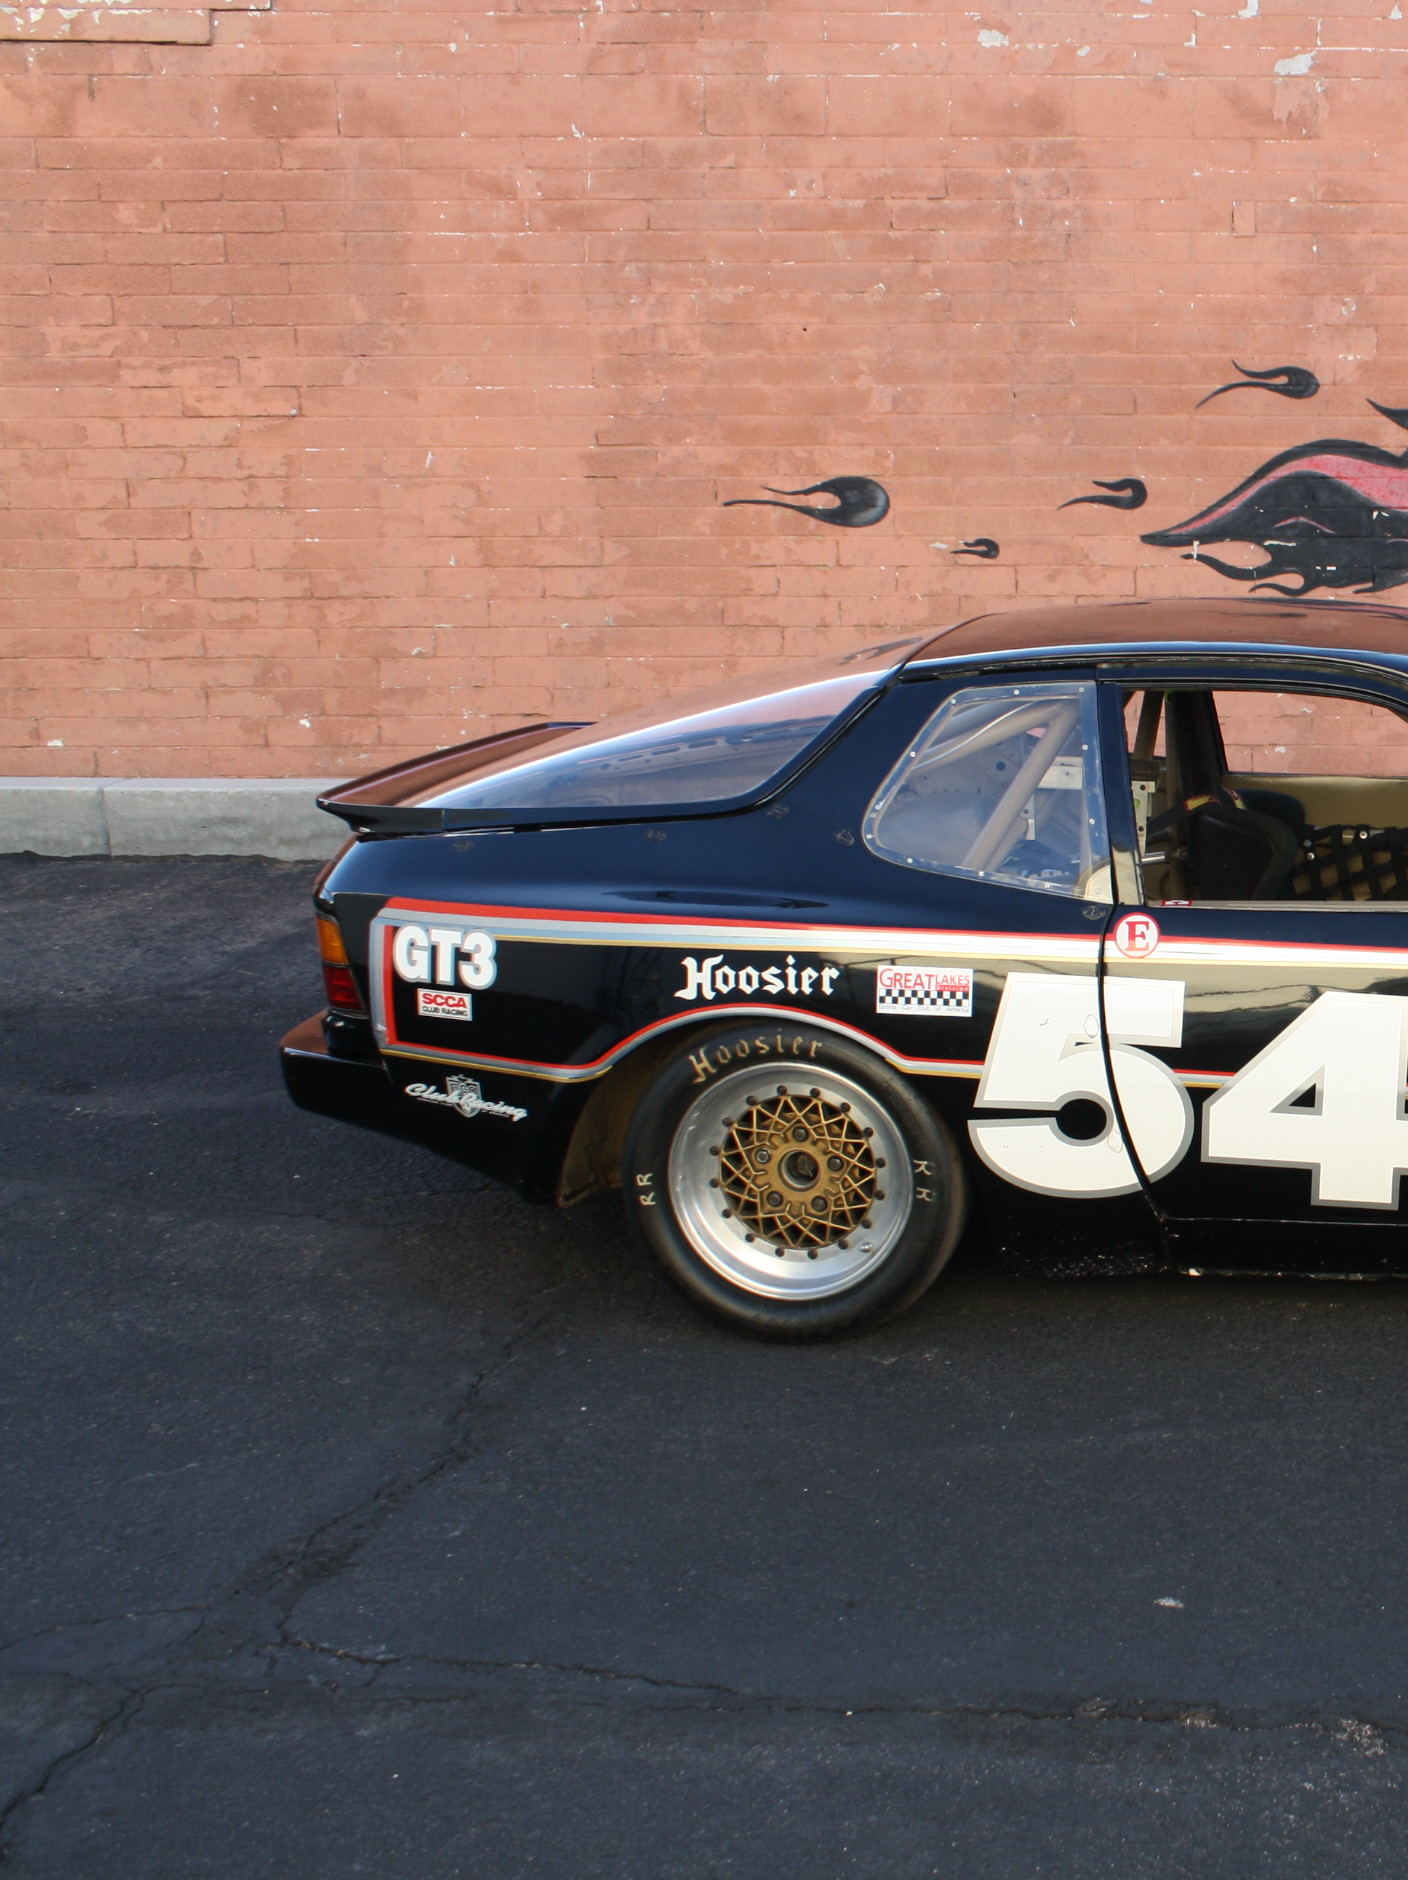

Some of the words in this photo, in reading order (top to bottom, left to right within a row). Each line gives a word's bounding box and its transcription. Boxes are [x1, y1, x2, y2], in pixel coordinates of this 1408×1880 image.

[1125, 921, 1150, 951] E
[393, 922, 498, 990] GT3
[674, 954, 841, 1001] Hoosier
[879, 968, 935, 990] GREAT
[422, 993, 468, 1009] SCCA
[422, 1005, 440, 1014] CLUB
[441, 1007, 468, 1017] RACING
[688, 1028, 824, 1084] Hoosier
[404, 1083, 461, 1104] Club
[459, 1092, 528, 1122] Racing
